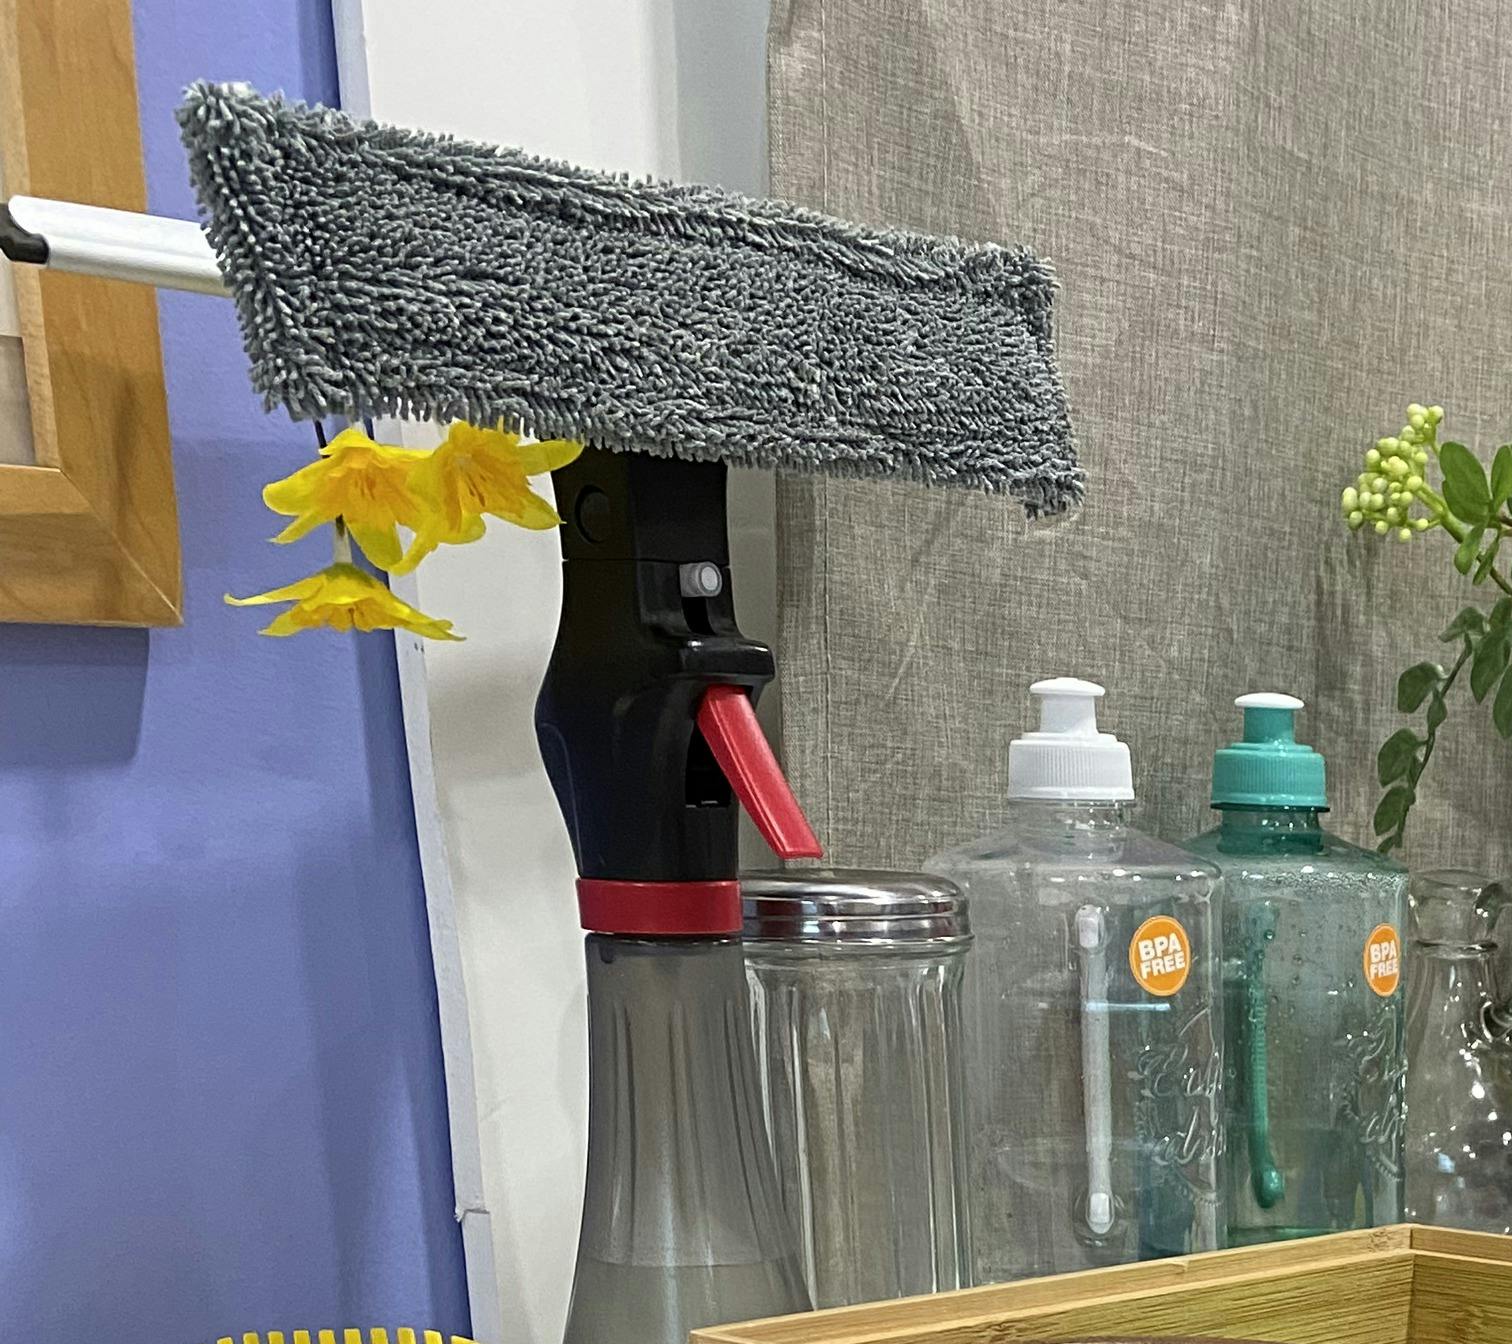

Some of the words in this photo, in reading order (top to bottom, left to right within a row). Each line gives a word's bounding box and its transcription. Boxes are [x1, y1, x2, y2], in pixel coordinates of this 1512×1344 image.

[1138, 932, 1182, 963] BPA
[1369, 940, 1397, 964] BPA
[1140, 951, 1186, 980] FREE
[1369, 958, 1399, 981] FREE
